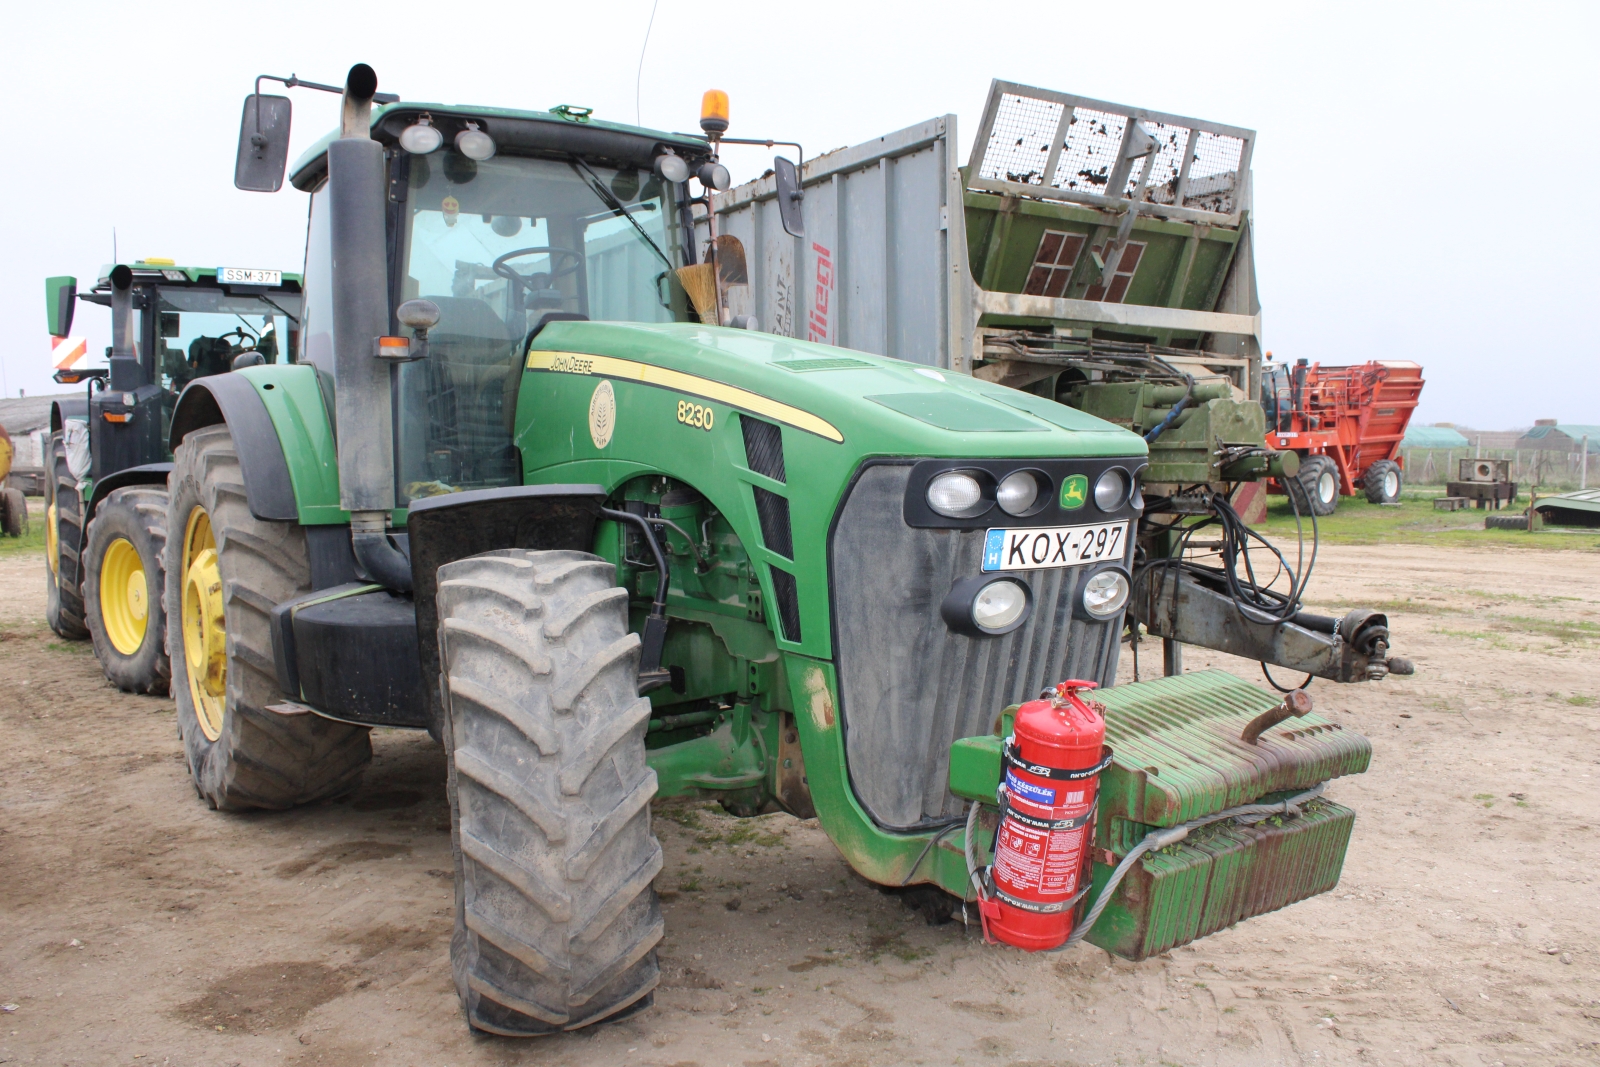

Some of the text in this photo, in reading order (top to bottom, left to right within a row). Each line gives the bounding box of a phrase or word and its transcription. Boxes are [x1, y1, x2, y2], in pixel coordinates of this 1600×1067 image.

[227, 270, 278, 282] SSM-371
[550, 354, 594, 373] JOHN DEERE
[677, 400, 714, 431] 8230
[1008, 527, 1122, 565] KOX-297
[988, 553, 998, 564] H
[1017, 779, 1053, 797] KÉSZÜLÉK
